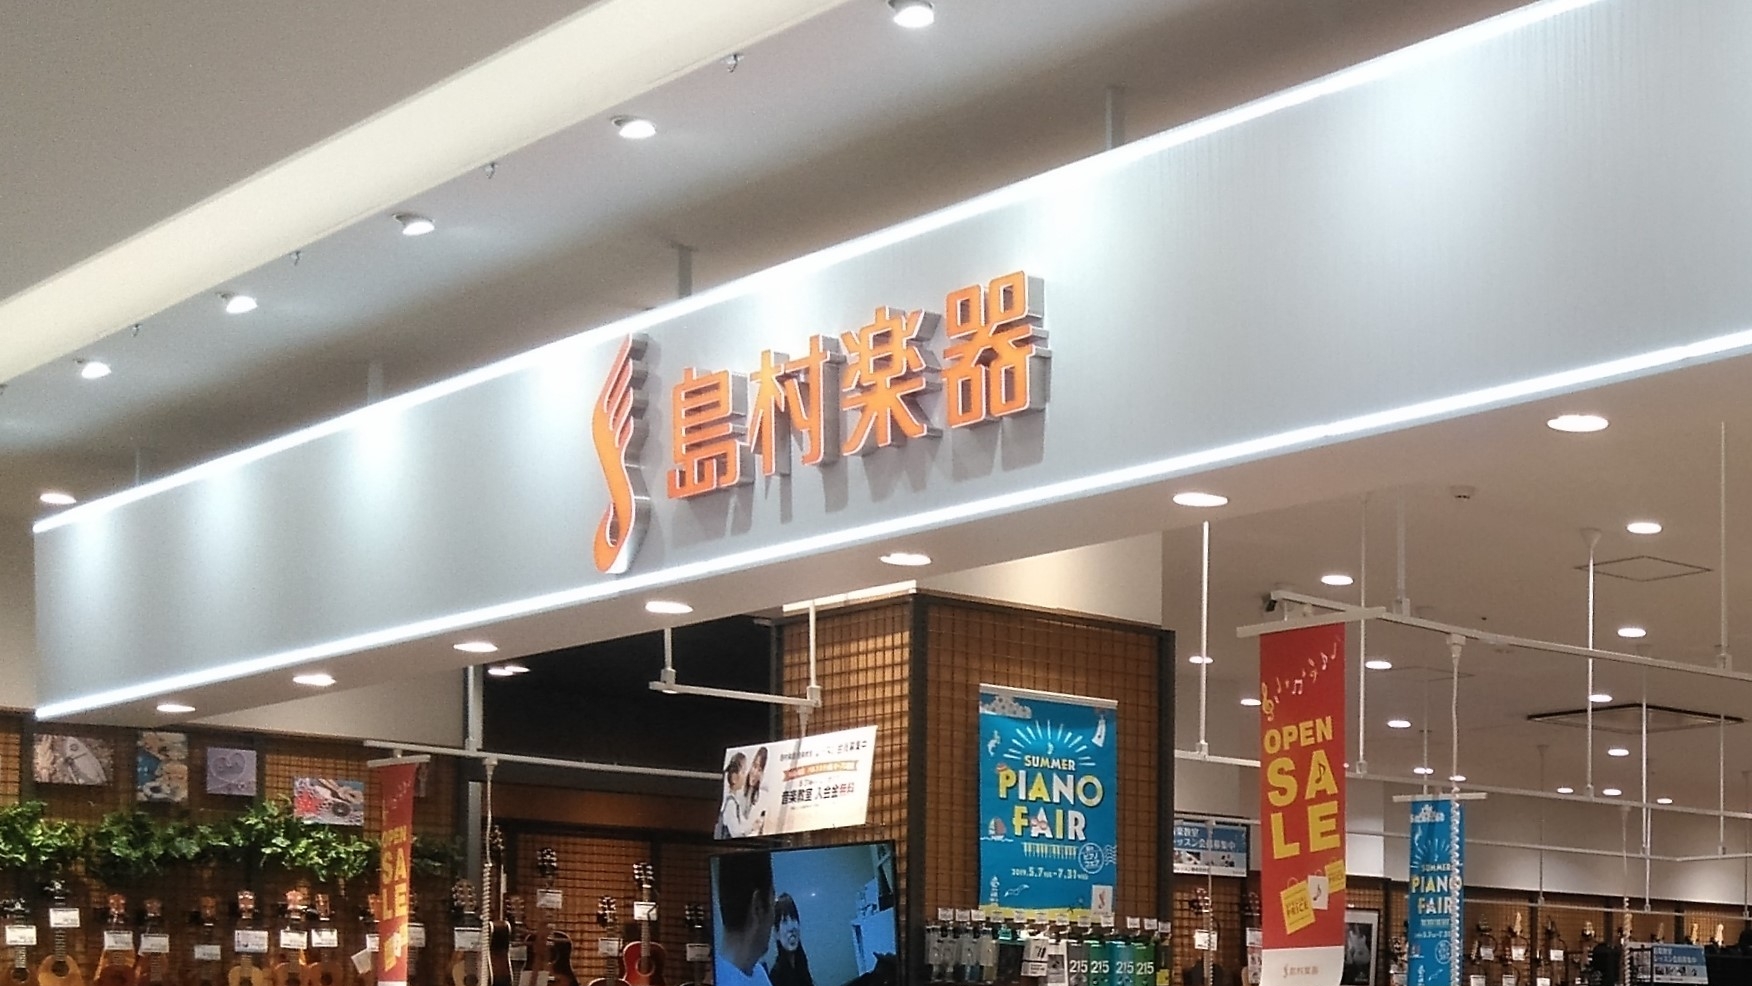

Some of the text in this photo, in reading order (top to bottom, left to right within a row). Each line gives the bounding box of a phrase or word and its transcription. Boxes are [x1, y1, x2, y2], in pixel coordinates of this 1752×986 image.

[667, 270, 1042, 499] 島村楽器
[1264, 716, 1333, 754] OPEN
[1024, 755, 1076, 771] SUMMER
[998, 768, 1104, 807] PIANO
[1012, 805, 1086, 841] FAIR
[1422, 863, 1452, 872] SUMMER
[1411, 875, 1463, 893] PIANO
[1069, 960, 1088, 973] 215
[1090, 960, 1110, 974] 215
[1115, 961, 1135, 974] 215
[1136, 962, 1154, 975] 215
